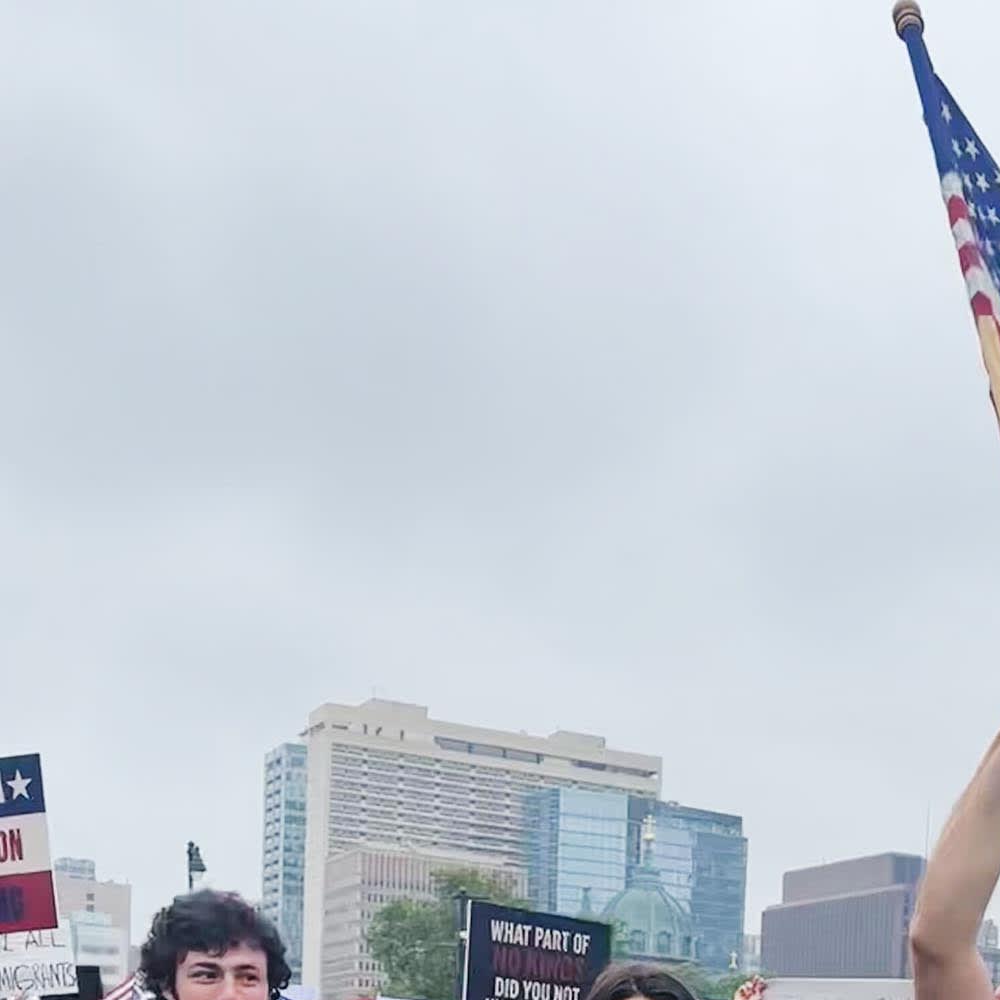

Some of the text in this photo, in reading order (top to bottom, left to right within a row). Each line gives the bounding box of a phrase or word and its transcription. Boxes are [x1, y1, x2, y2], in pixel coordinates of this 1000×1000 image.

[490, 919, 591, 956] WHAT PART OF
[494, 976, 520, 999] DID
